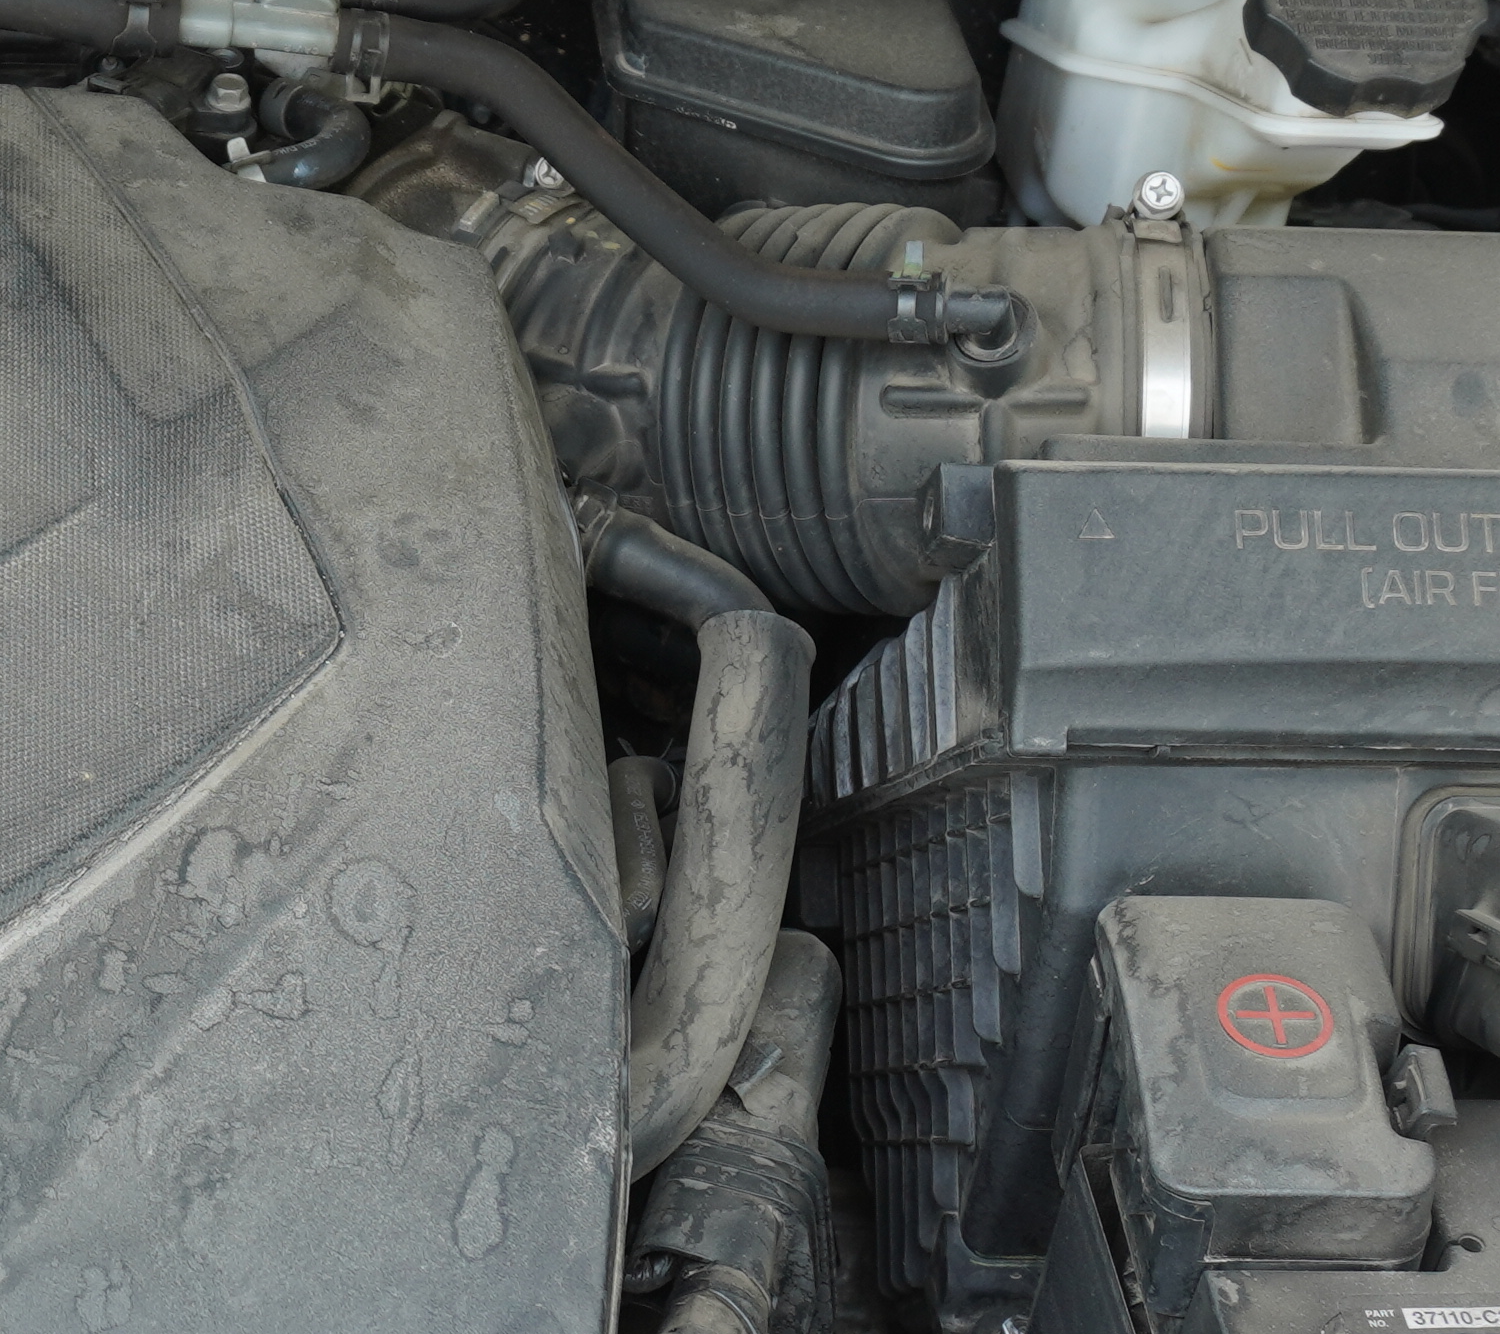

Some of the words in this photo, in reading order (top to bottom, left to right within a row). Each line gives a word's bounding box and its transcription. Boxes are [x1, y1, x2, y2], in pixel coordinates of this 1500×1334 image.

[1233, 508, 1377, 552] PULL
[1364, 1309, 1394, 1318] PART
[1369, 1319, 1389, 1328] NO.
